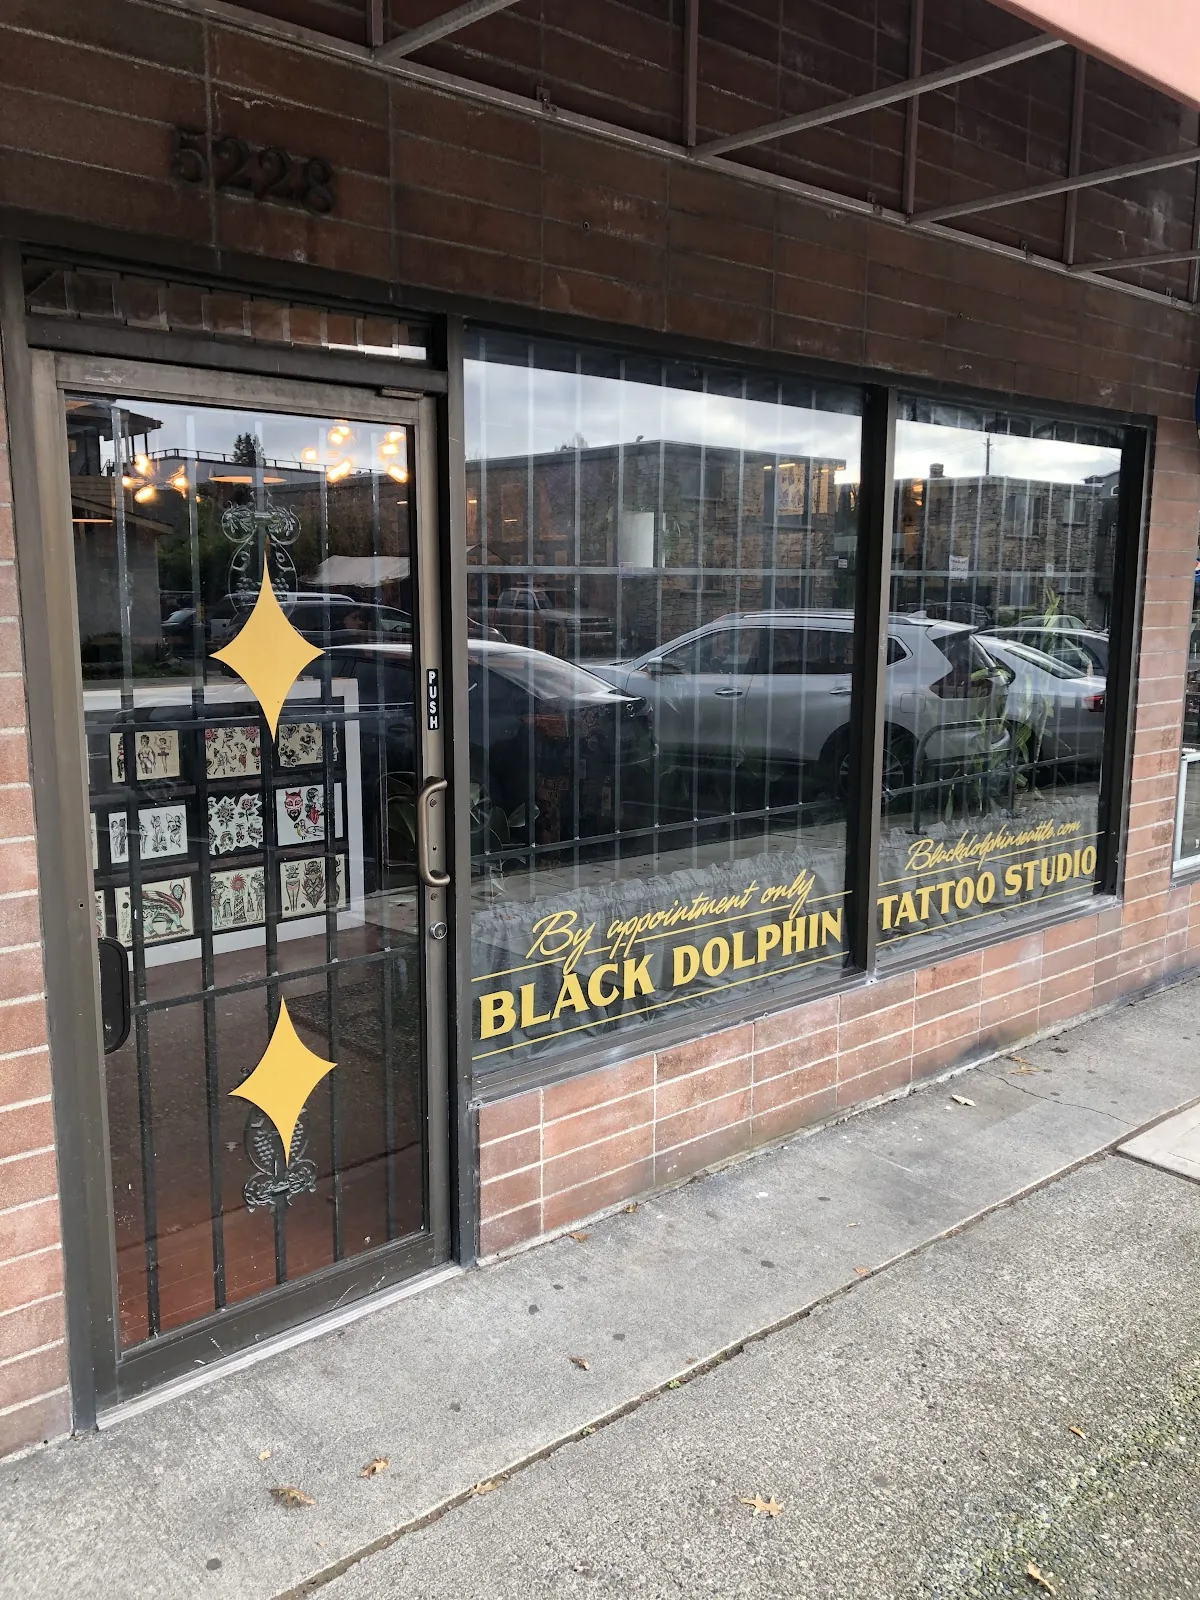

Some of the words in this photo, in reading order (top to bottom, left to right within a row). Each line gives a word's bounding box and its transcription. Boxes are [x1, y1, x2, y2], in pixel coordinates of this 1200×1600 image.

[172, 123, 336, 215] 5228
[428, 670, 438, 729] PUSH
[877, 871, 995, 931] TATTOO
[1004, 845, 1097, 897] STUDIO
[905, 818, 1081, 871] Blackdolphinseattle.com
[525, 910, 596, 974] By
[606, 879, 760, 959] appointment
[760, 868, 816, 919] only
[479, 953, 656, 1040] BLACK
[672, 907, 844, 987] DOLPHIN
